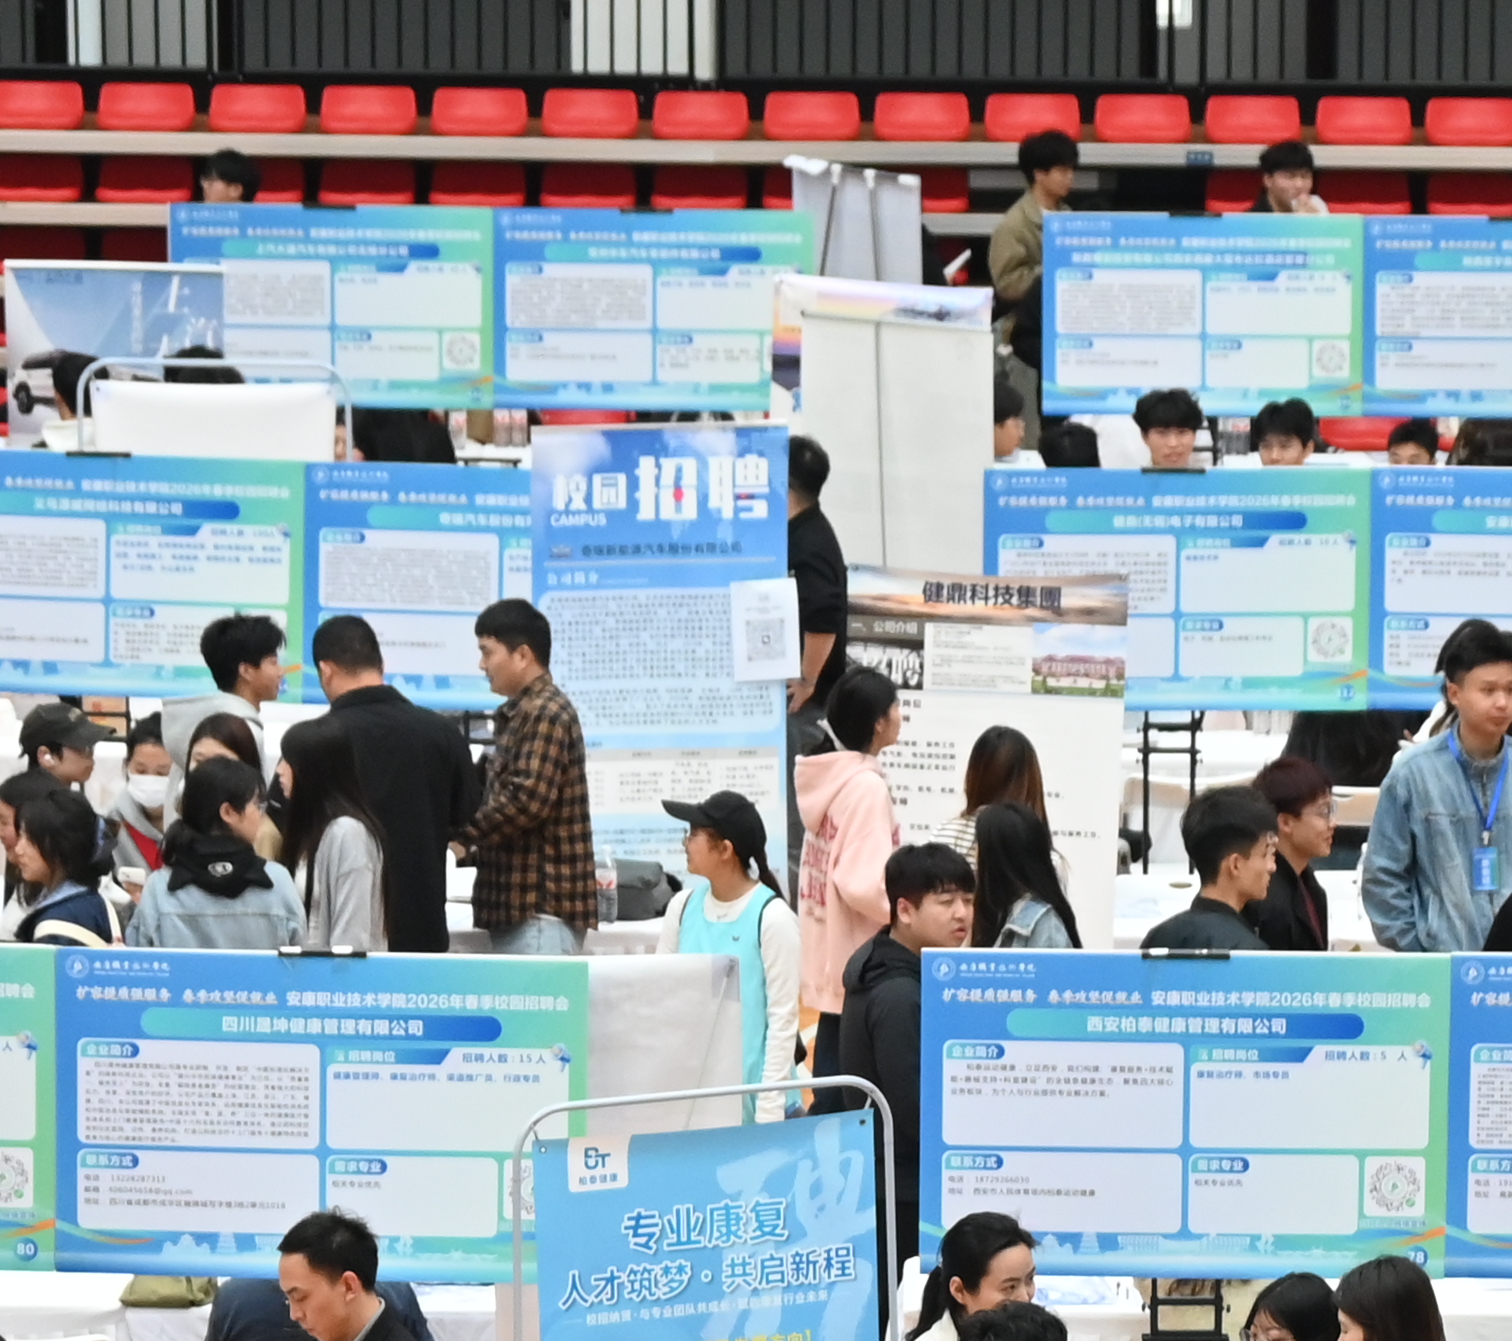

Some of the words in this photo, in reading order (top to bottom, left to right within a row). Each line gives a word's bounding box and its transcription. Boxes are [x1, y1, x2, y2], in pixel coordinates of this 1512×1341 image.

[551, 471, 627, 512] 校园
[635, 453, 770, 523] 招聘
[550, 512, 607, 528] CAMPUS
[286, 991, 569, 1012] 安康职业技术学院2026年春季校园招聘会
[222, 1015, 425, 1037] 四川晟坤健康管理有限公司
[1087, 1016, 1287, 1035] 西安柏泰健康管理有限公司
[621, 1199, 788, 1255] 专业康复
[16, 1242, 34, 1256] 80
[558, 1244, 857, 1310] 人才筑梦·共启新程
